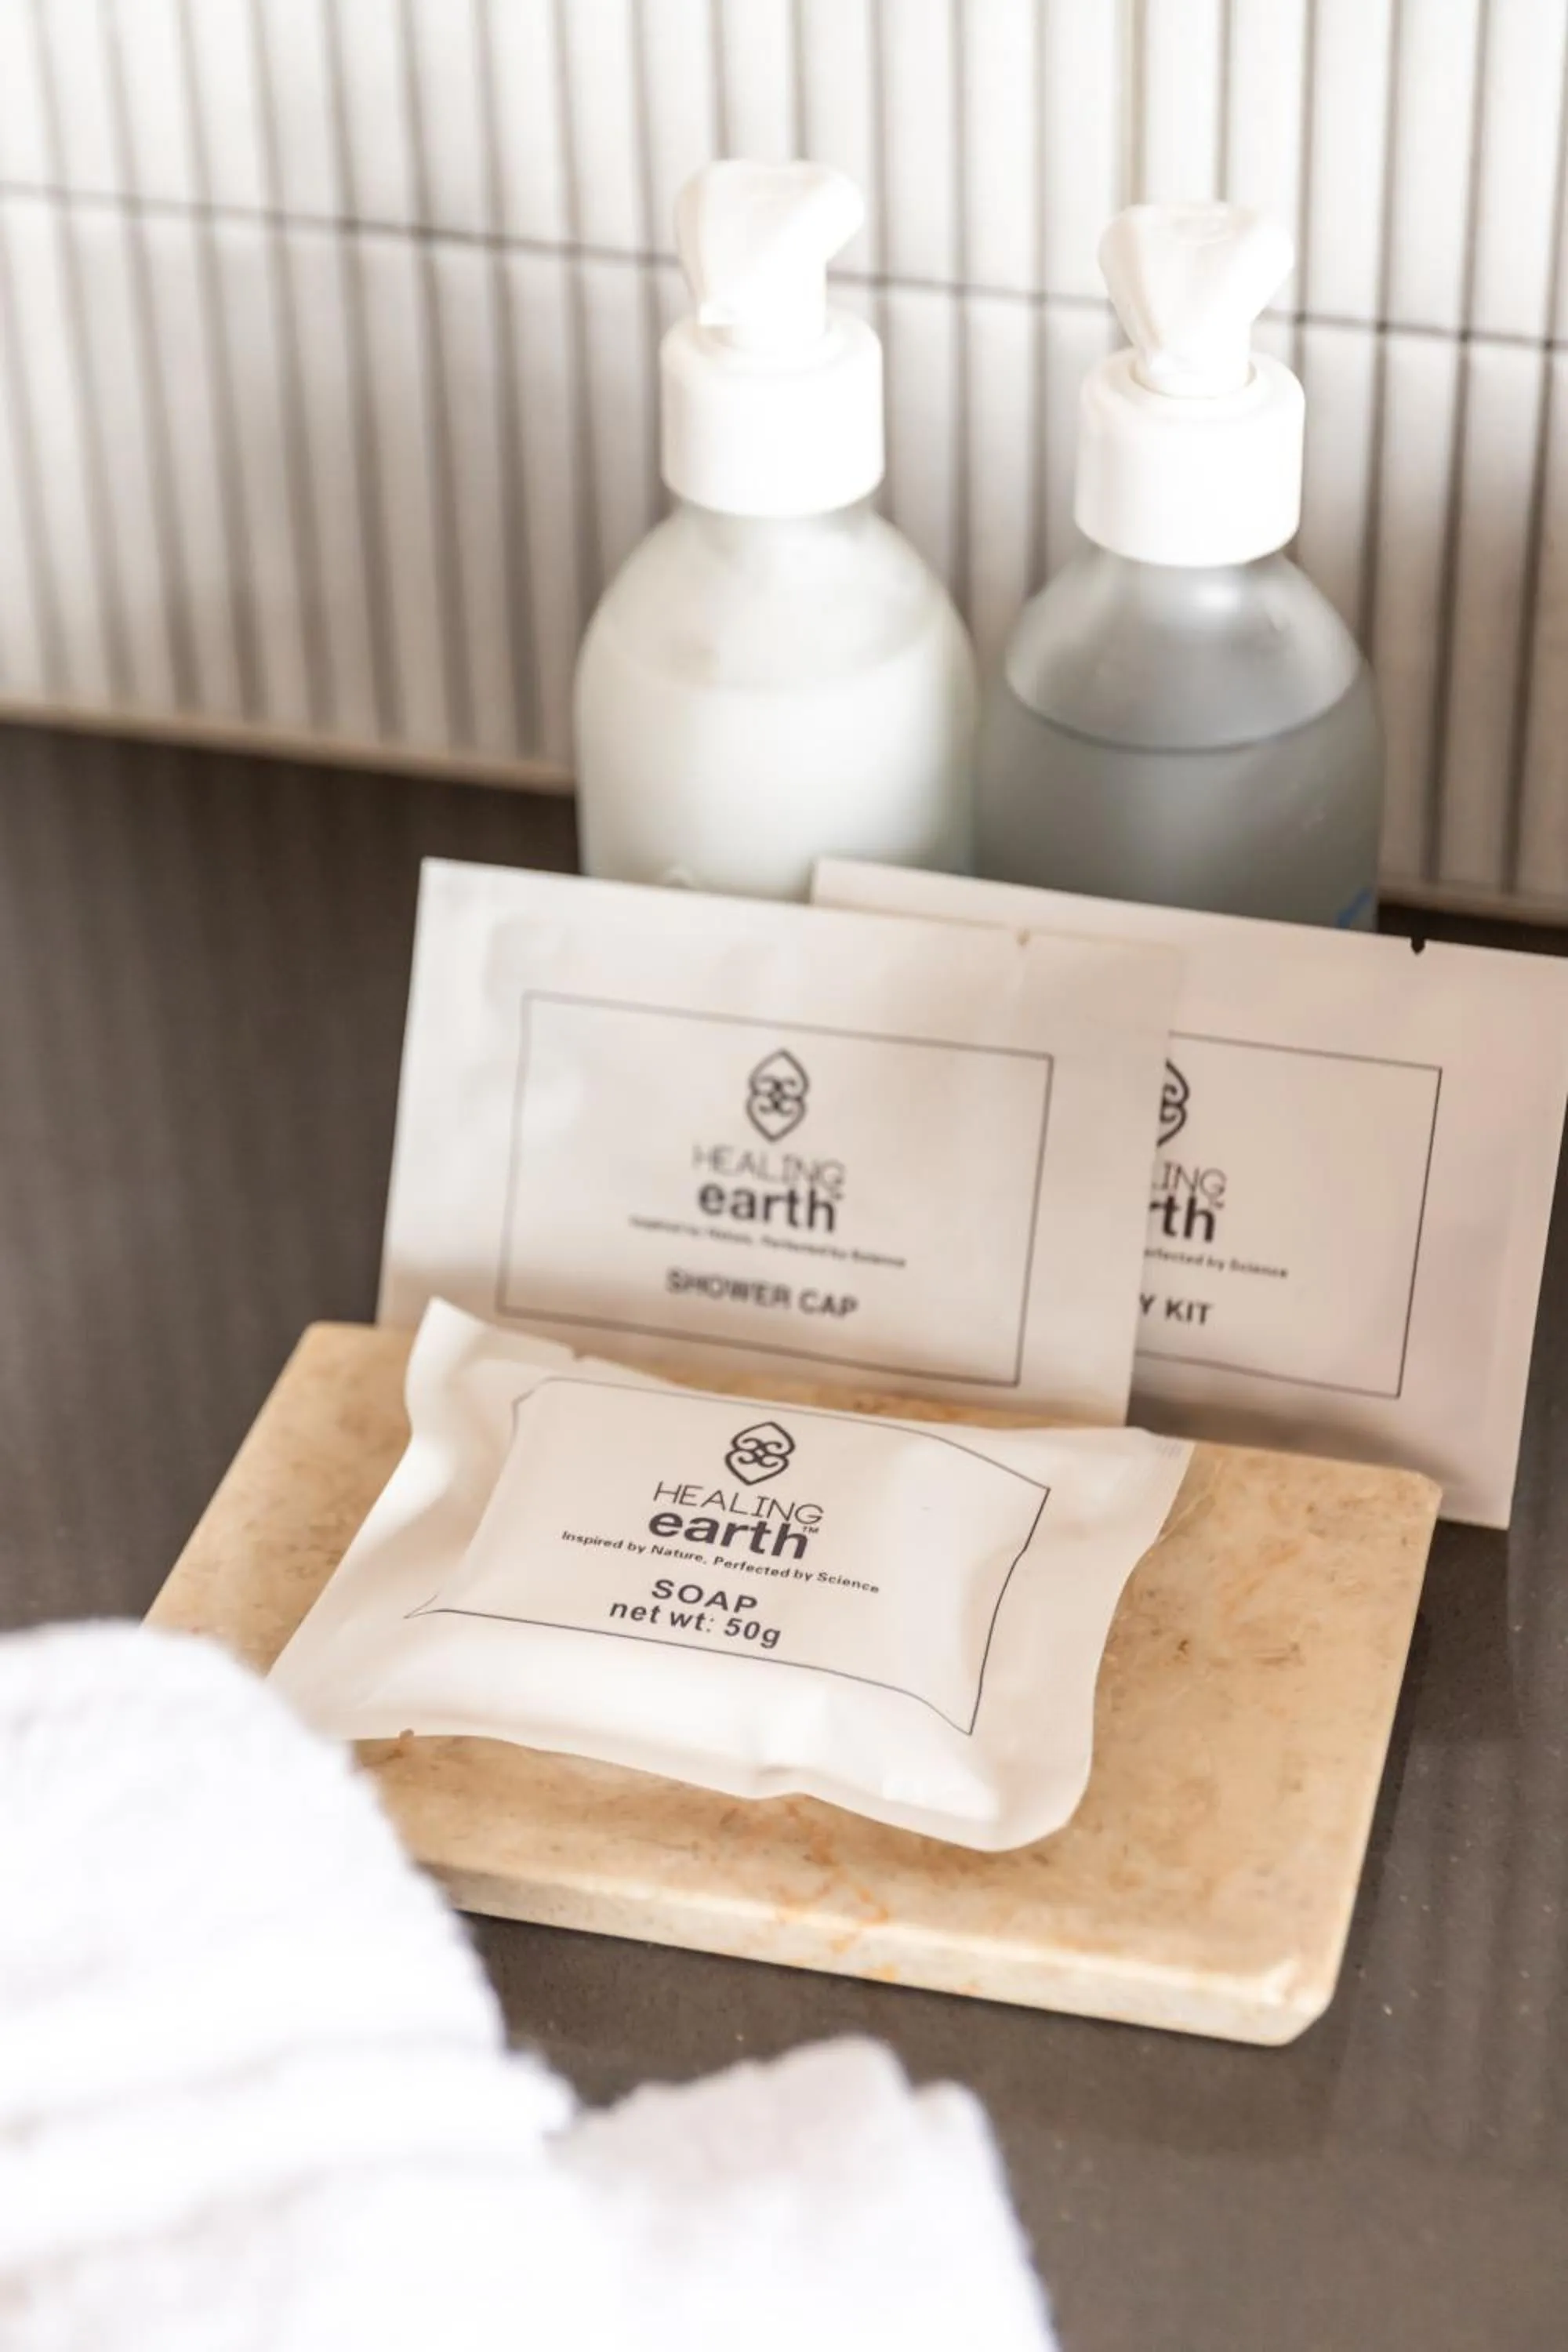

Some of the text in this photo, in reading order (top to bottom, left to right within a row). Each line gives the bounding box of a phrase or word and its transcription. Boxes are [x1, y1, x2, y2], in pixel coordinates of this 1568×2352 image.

[691, 1144, 847, 1187] HEALING
[698, 1181, 836, 1232] earth
[667, 1266, 860, 1320] SHOWER CAP
[1165, 1296, 1214, 1327] KIT
[653, 1480, 824, 1525] HEALING
[648, 1512, 808, 1559] earth
[561, 1530, 624, 1550] Inspired
[627, 1541, 647, 1555] by
[713, 1555, 791, 1579] Perfected
[793, 1569, 814, 1582] by
[817, 1571, 880, 1595] Science
[652, 1579, 757, 1613] SOAP
[609, 1602, 781, 1650] net wt: 50g
